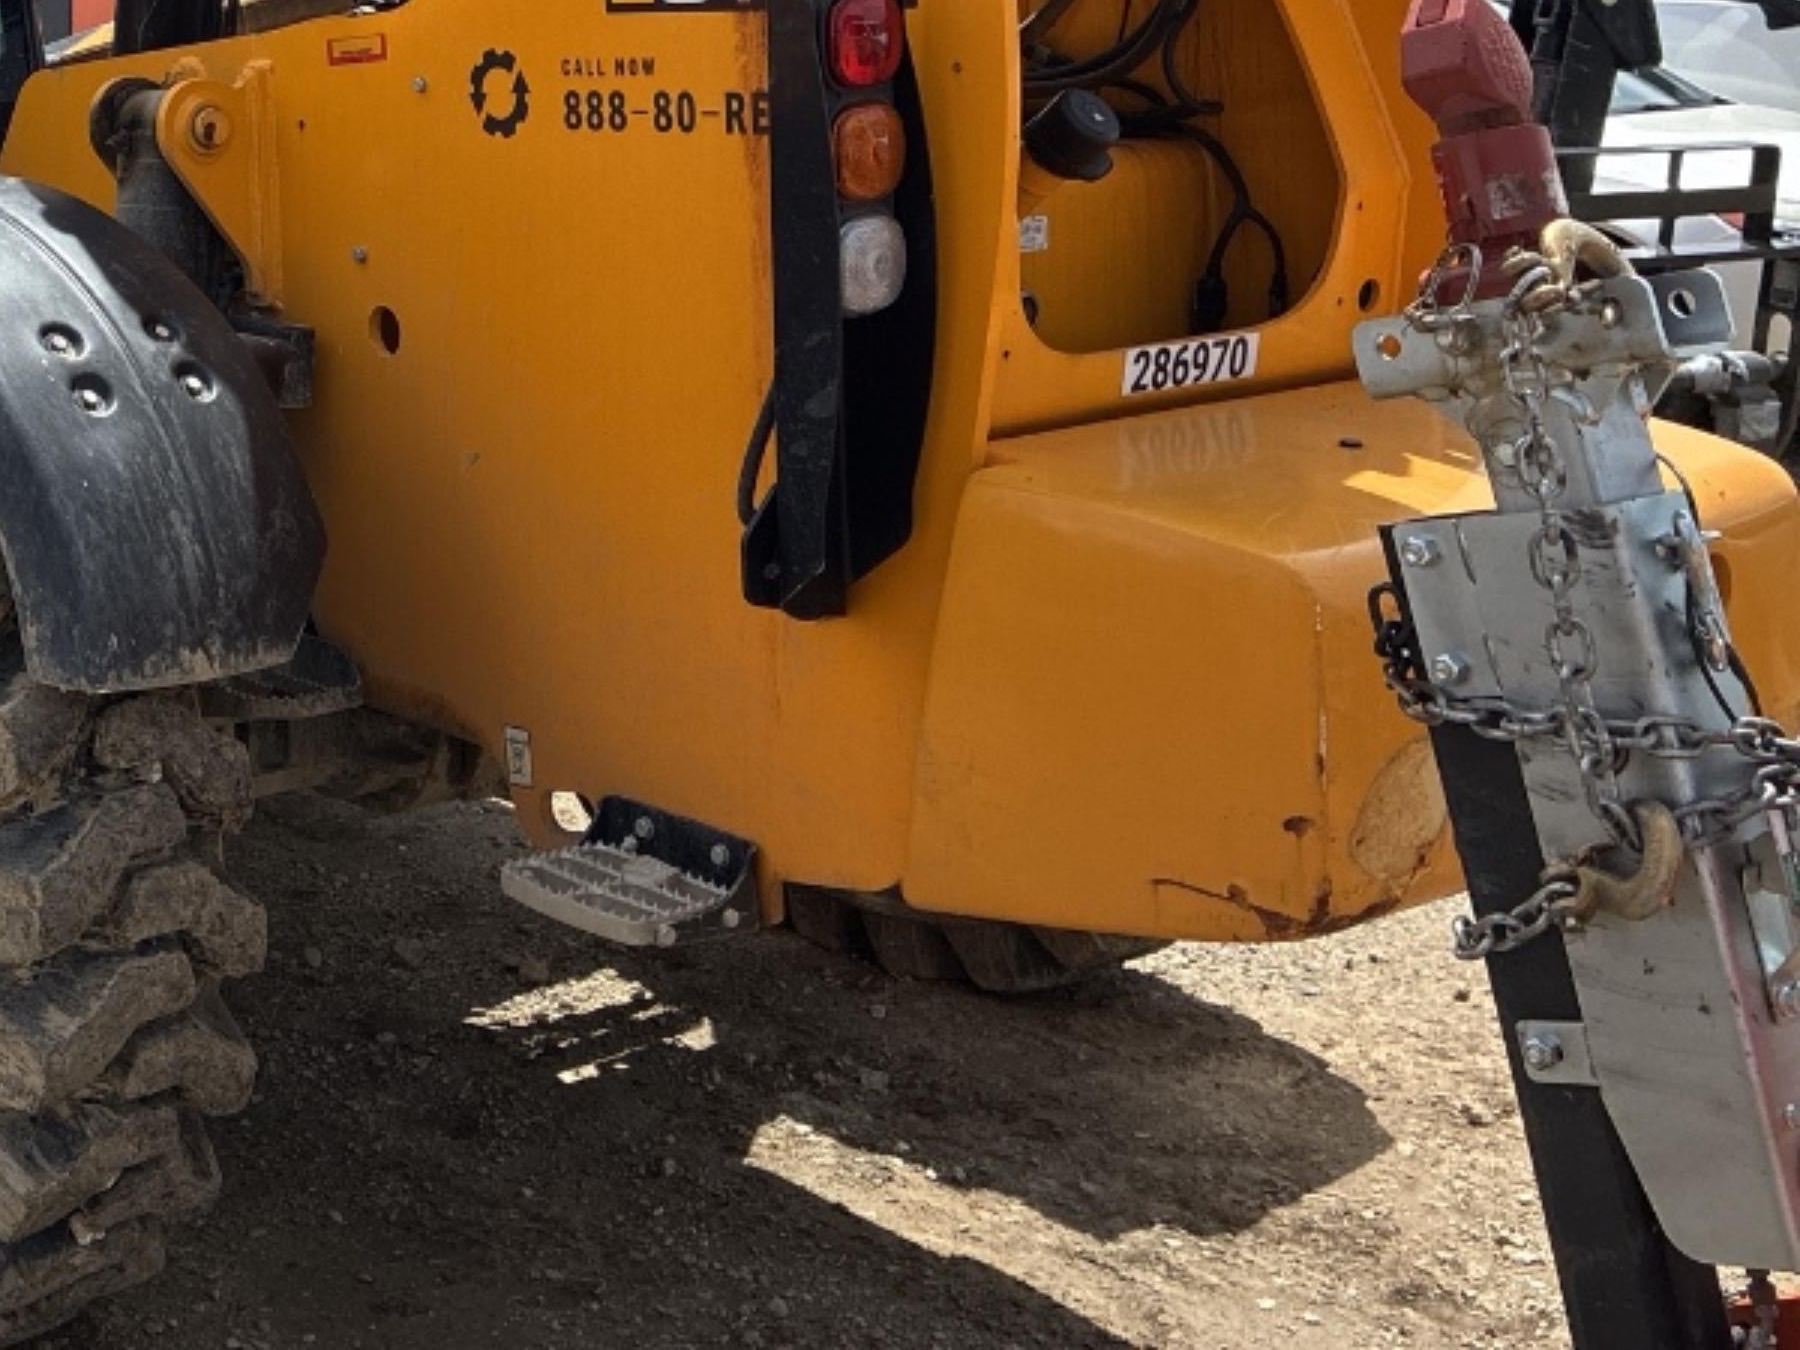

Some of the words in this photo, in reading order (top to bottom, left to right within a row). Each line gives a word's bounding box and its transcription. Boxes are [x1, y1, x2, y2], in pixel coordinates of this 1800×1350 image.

[561, 58, 605, 76] CALL
[615, 57, 655, 75] NOW
[1130, 336, 1248, 393] 286970
